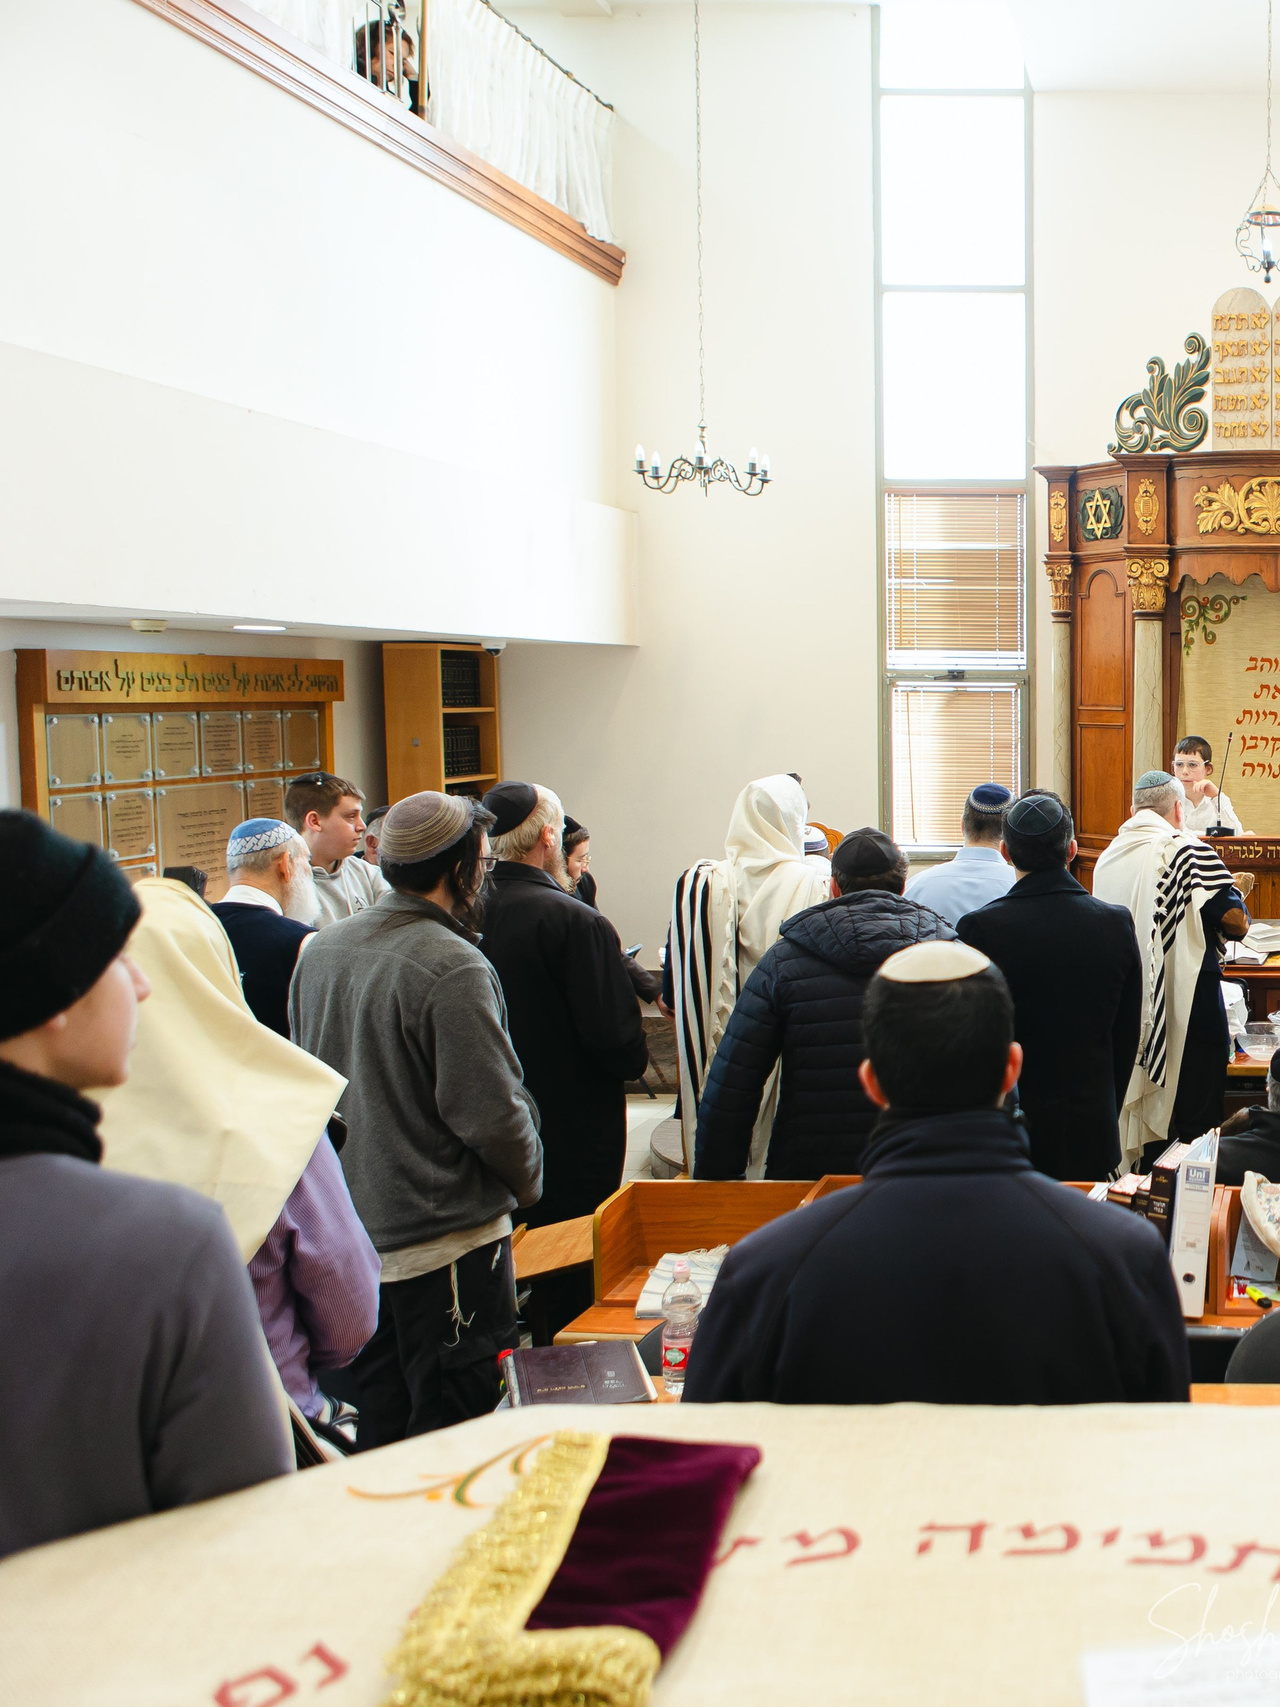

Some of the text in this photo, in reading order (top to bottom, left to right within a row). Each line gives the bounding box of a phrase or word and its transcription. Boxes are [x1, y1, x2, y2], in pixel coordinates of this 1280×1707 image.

[1213, 306, 1270, 331] לא תרצח
[1214, 332, 1270, 362] לא תנאף
[1214, 360, 1270, 384] לא תגנב
[1213, 388, 1270, 411] לא תענה
[1214, 414, 1270, 438] לא תחמד
[57, 670, 113, 692] אבותם
[114, 658, 135, 698] על
[140, 672, 172, 693] בנים
[175, 661, 200, 693] ולב
[202, 672, 231, 693] בנים
[232, 661, 250, 697] על
[254, 673, 286, 693] אבות
[287, 663, 303, 692] לב
[1229, 841, 1263, 859] לנגדי
